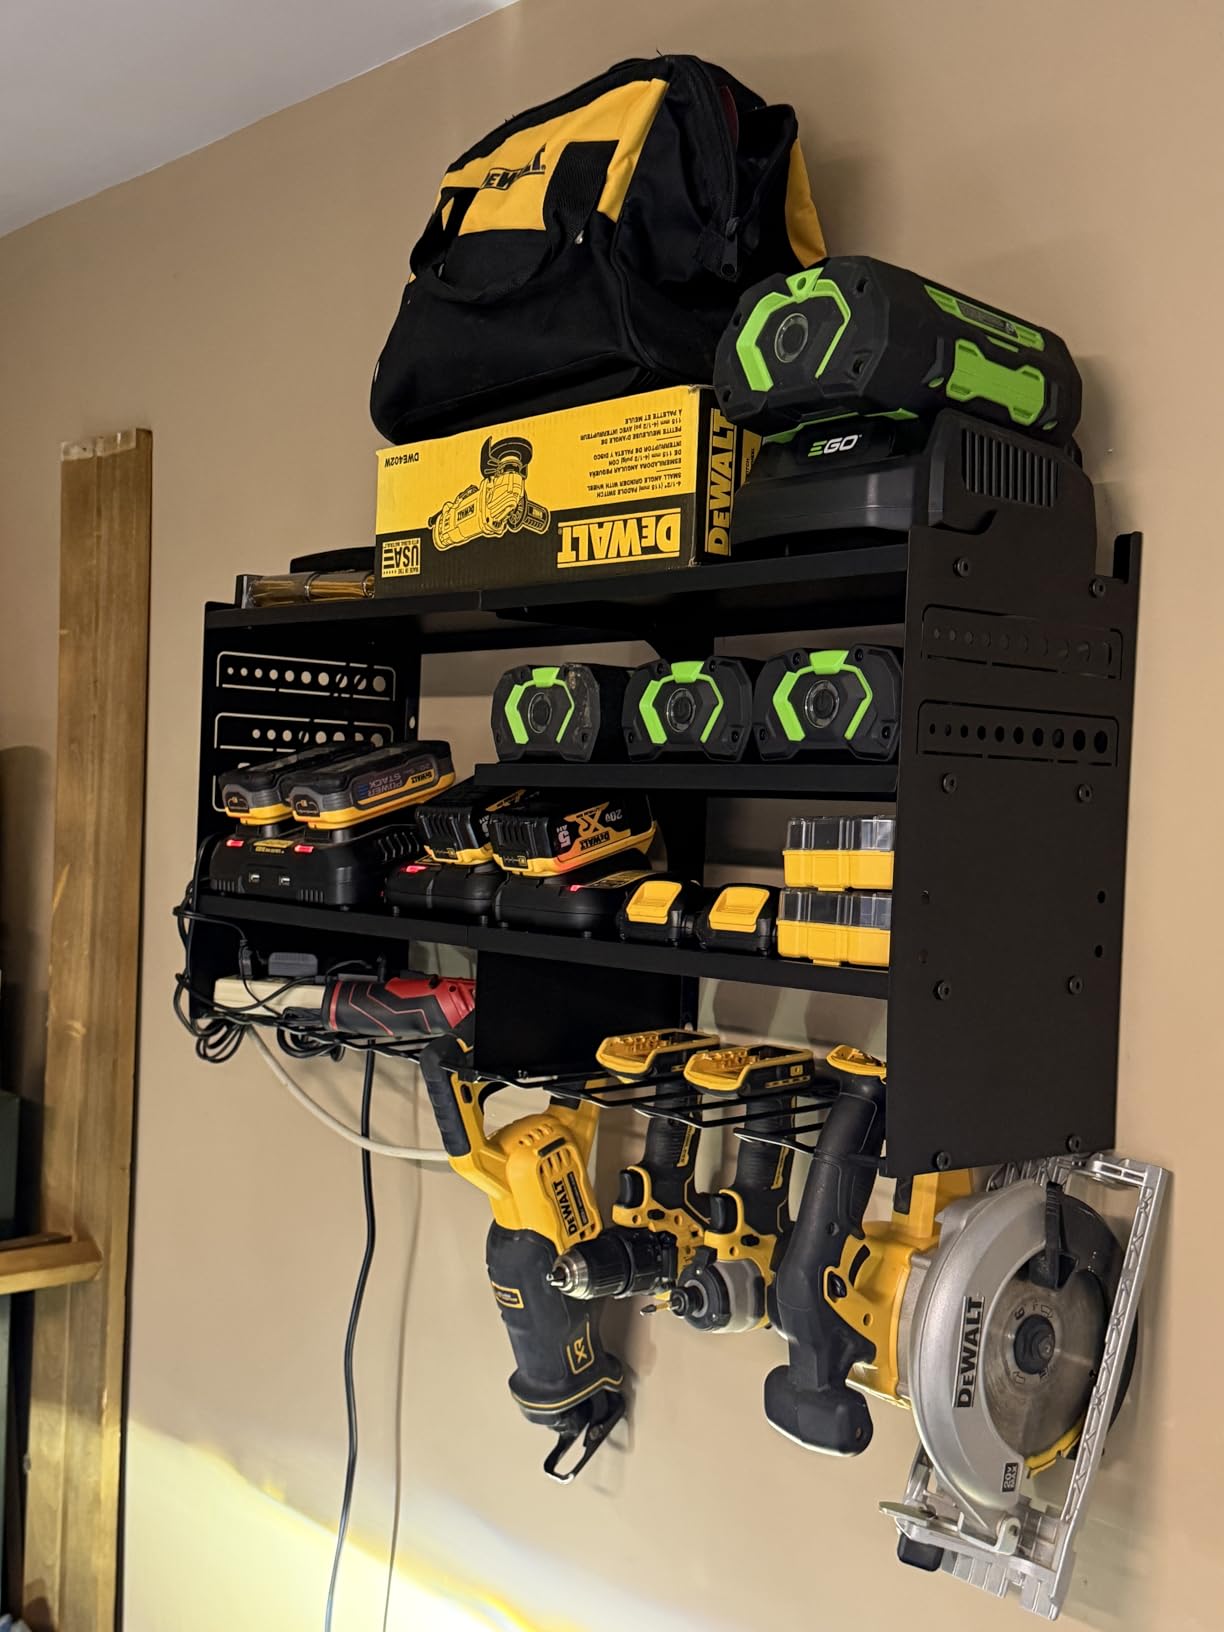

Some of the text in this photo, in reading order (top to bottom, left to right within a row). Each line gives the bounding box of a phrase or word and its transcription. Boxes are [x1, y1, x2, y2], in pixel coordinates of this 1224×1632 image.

[625, 415, 643, 425] MEULE
[653, 410, 677, 420] PALETTE
[619, 426, 632, 434] AVEC
[663, 426, 681, 434] PETITE
[615, 448, 633, 457] PALETA
[644, 441, 681, 452] INTERRUPTOR
[808, 435, 858, 457] EGO
[385, 452, 419, 467] DWE402W
[593, 452, 608, 460] DISCO
[614, 464, 638, 472] ANGULAR
[708, 408, 734, 555] DEWALT
[557, 513, 679, 563] DEWALT
[394, 546, 418, 568] USA
[369, 773, 401, 788] STACK
[558, 830, 571, 848] 5
[553, 1180, 577, 1235] DEWALT
[956, 1296, 983, 1408] DEWALT
